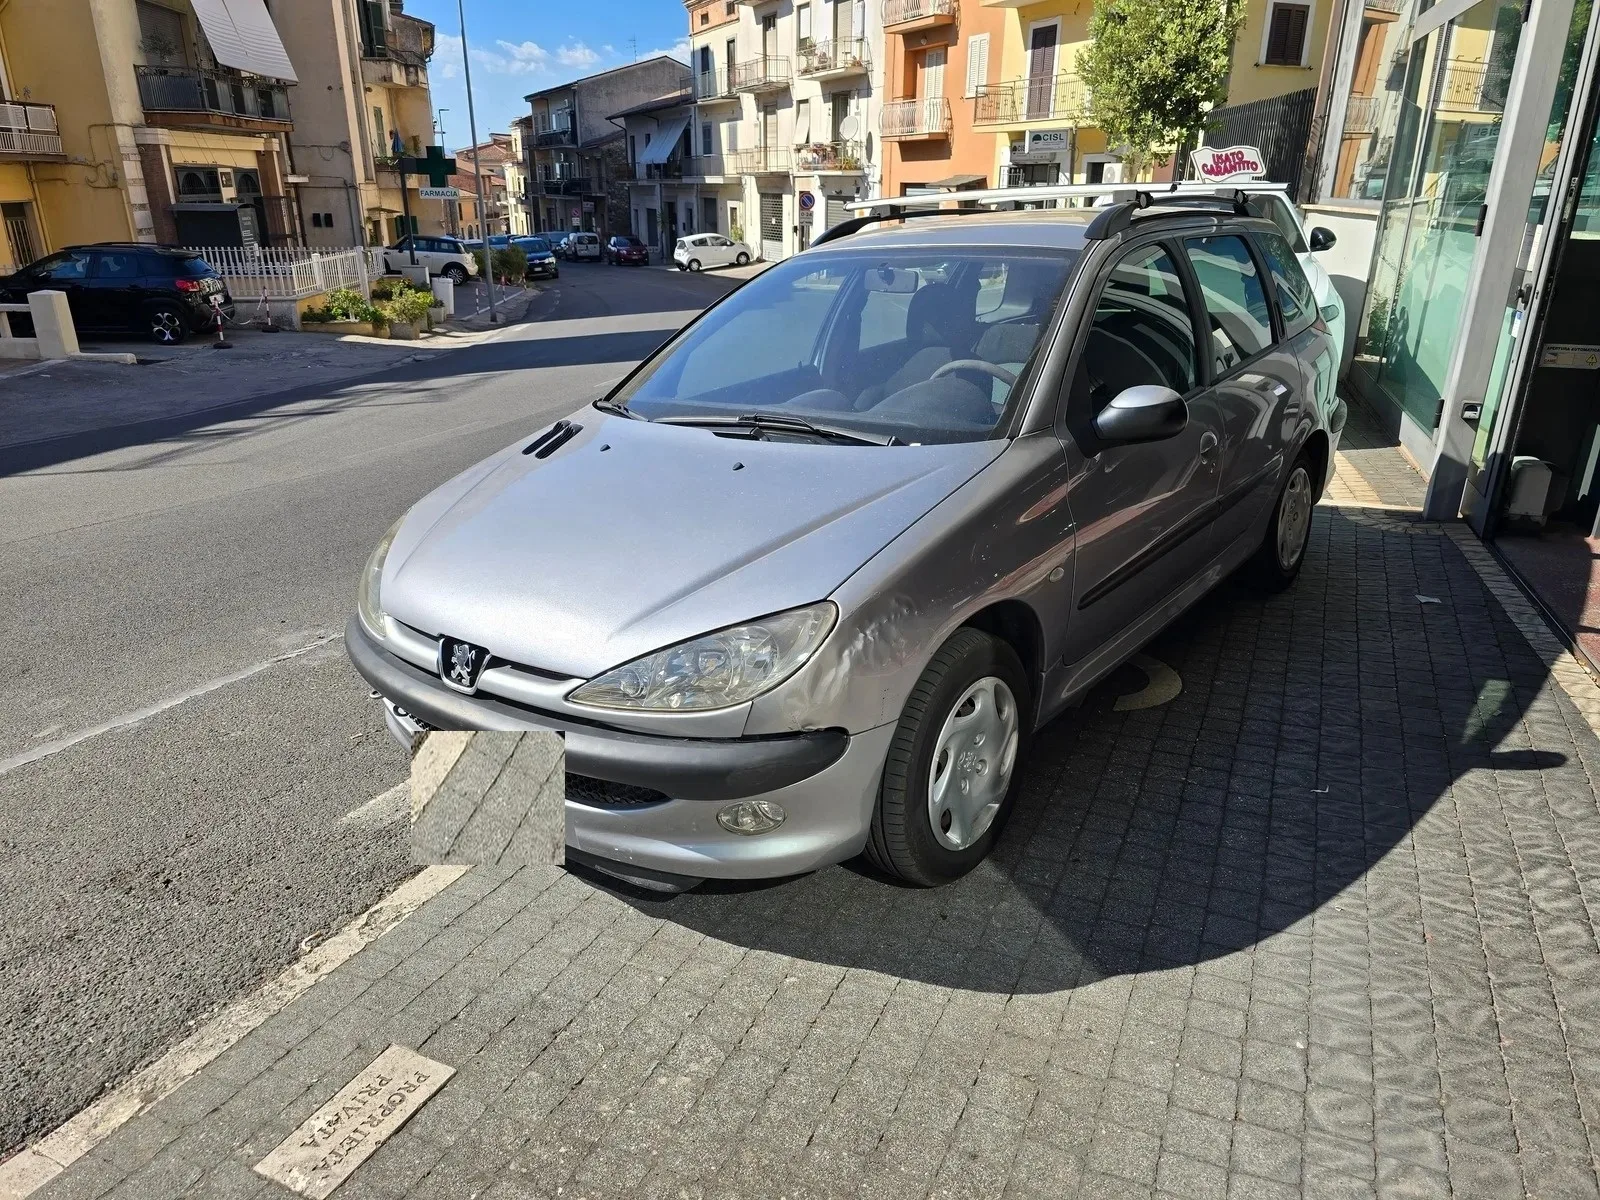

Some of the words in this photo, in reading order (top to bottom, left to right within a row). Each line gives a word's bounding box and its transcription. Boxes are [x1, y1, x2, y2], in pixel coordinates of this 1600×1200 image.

[1043, 133, 1064, 141] CISL
[1212, 150, 1244, 165] USATO
[1201, 160, 1258, 176] GARANTITO
[299, 1074, 392, 1148] PRIVATA
